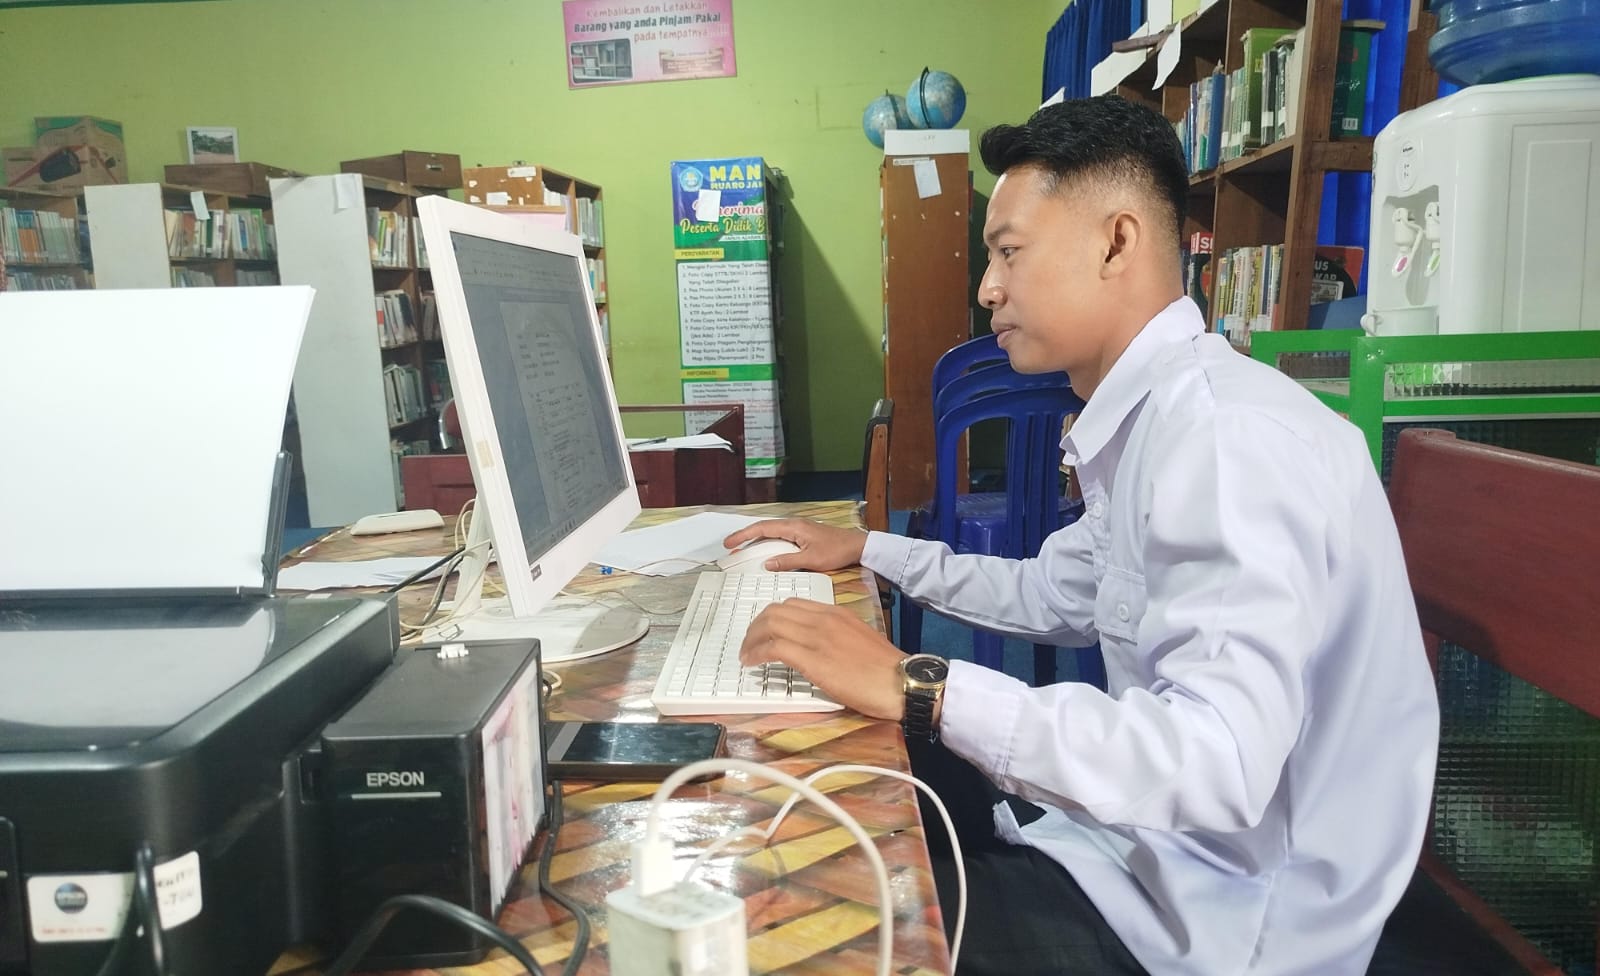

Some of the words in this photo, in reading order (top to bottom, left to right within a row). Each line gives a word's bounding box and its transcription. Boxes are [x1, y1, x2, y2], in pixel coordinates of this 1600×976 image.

[643, 4, 660, 14] dan
[663, 1, 707, 13] Letakkan
[574, 21, 607, 33] Barang
[609, 19, 631, 31] yang
[634, 17, 657, 28] anda
[659, 15, 692, 27] Pinjam
[695, 13, 721, 23] Pakai
[634, 32, 656, 43] pada
[710, 165, 761, 181] MAN
[680, 218, 720, 234] Peserta
[722, 216, 753, 234] Didik
[366, 771, 425, 787] EPSON
